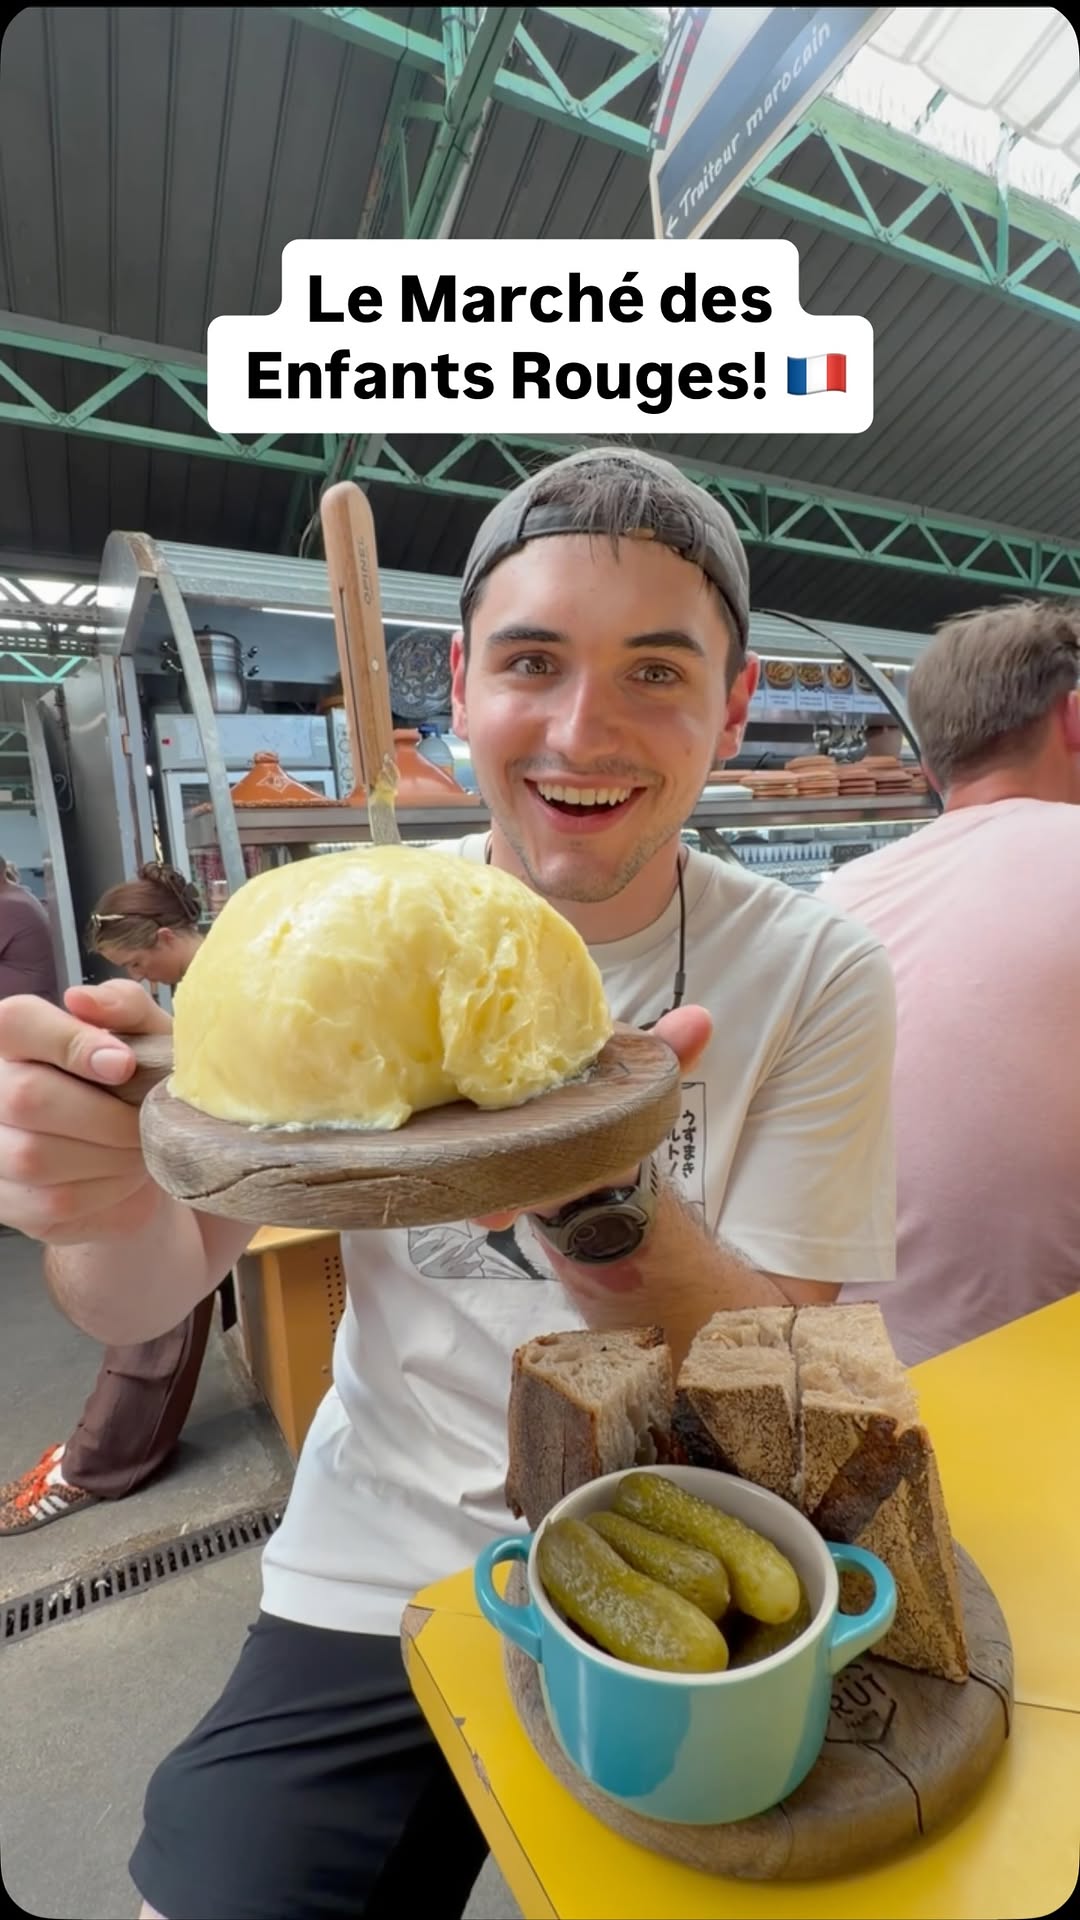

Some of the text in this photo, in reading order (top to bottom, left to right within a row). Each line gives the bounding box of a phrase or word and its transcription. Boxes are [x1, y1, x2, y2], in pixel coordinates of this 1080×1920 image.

[679, 21, 831, 216] Traiteur marocain
[682, 1109, 697, 1178] うずまき
